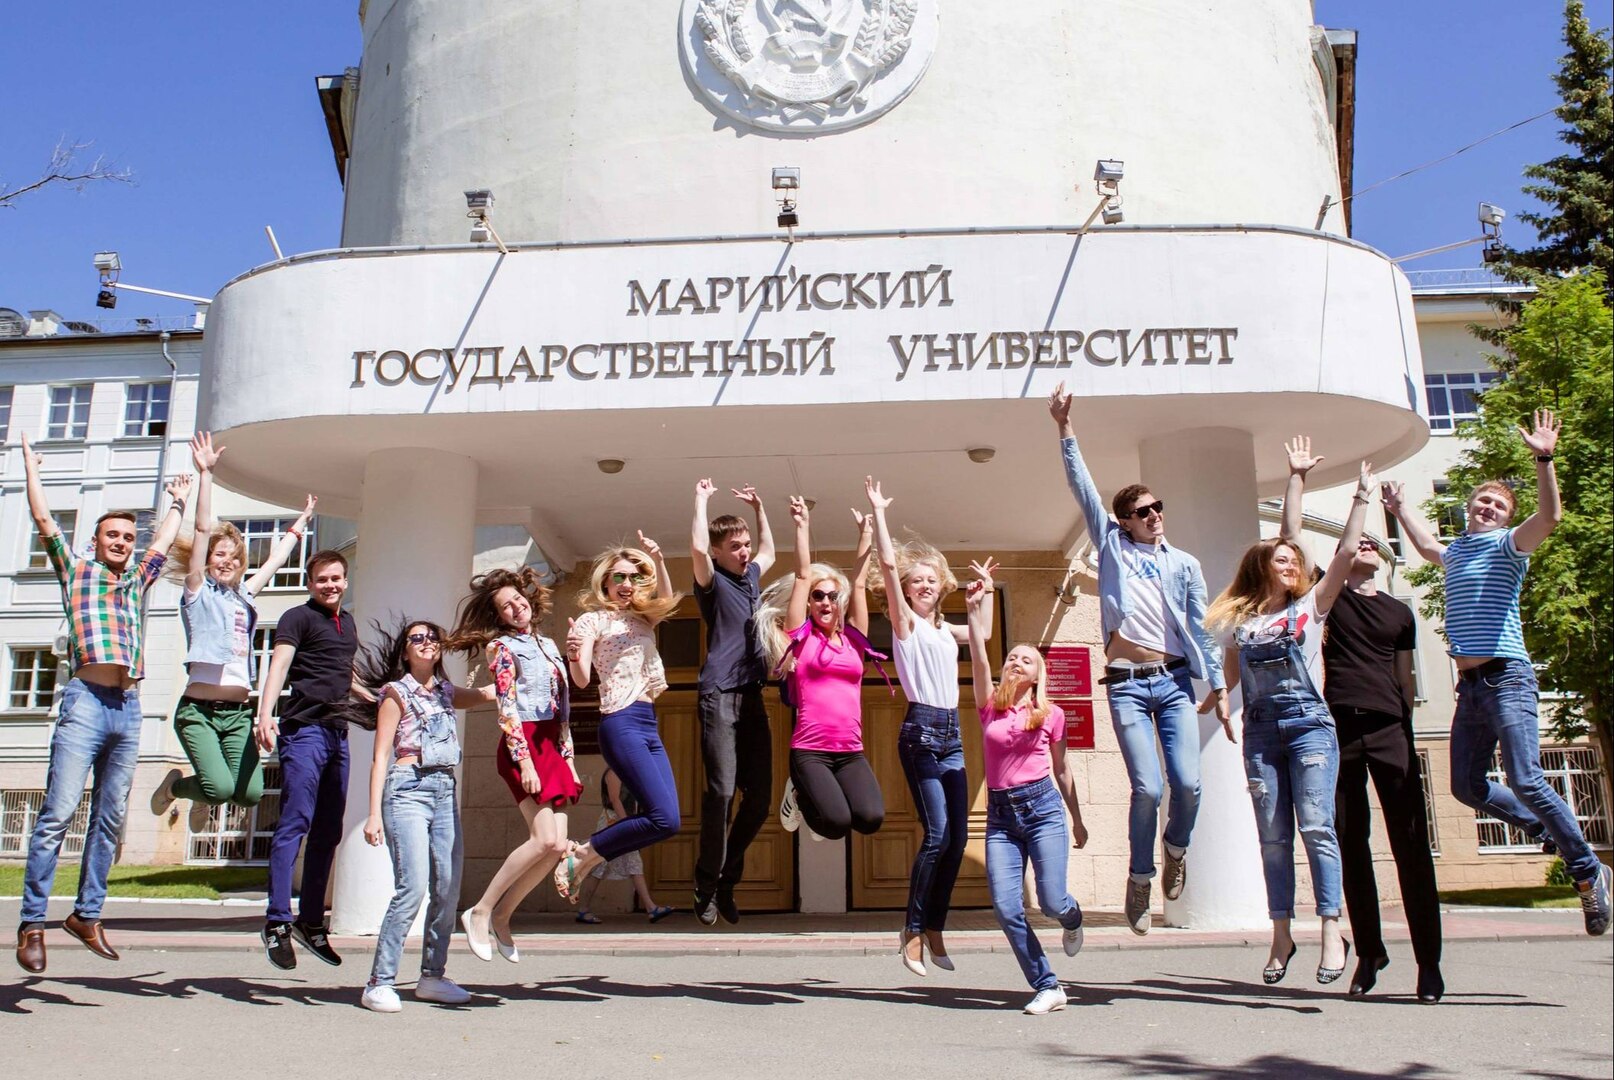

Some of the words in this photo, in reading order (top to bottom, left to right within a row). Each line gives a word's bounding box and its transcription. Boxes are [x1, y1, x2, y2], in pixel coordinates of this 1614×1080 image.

[626, 264, 954, 317] МАРИЙСКИЙ
[350, 331, 837, 394] ГОСУДАРСТВЕННЫЙ
[887, 327, 1239, 382] УНИВЕРСИТЕТ
